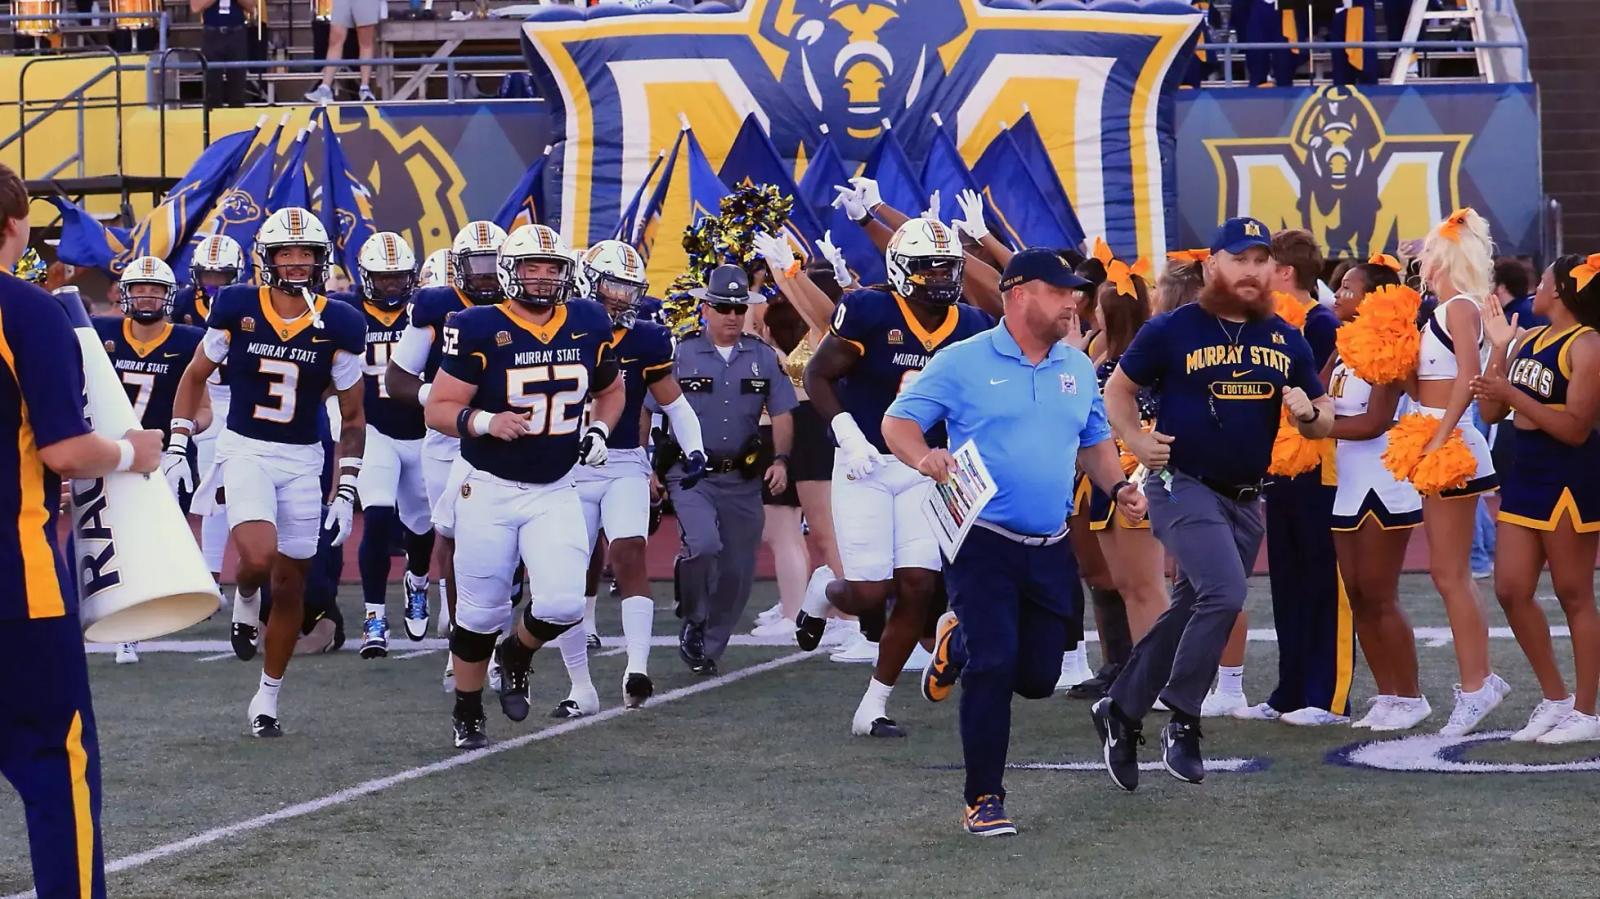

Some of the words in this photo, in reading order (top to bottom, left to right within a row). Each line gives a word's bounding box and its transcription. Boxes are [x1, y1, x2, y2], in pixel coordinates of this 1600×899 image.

[365, 331, 392, 342] URRAY
[442, 326, 459, 356] 52
[247, 342, 288, 358] MURRAY
[289, 348, 318, 363] STATE
[515, 350, 553, 365] MURRAY
[557, 348, 581, 362] STATE
[892, 352, 931, 367] MURRAY
[1186, 345, 1244, 374] MURRAY
[1250, 345, 1291, 379] STATE
[115, 359, 145, 371] MURRAY
[147, 363, 169, 374] STATE
[123, 372, 156, 422] 7
[252, 358, 300, 423] 3
[506, 364, 589, 436] 52
[1222, 384, 1262, 395] FOOTBALL
